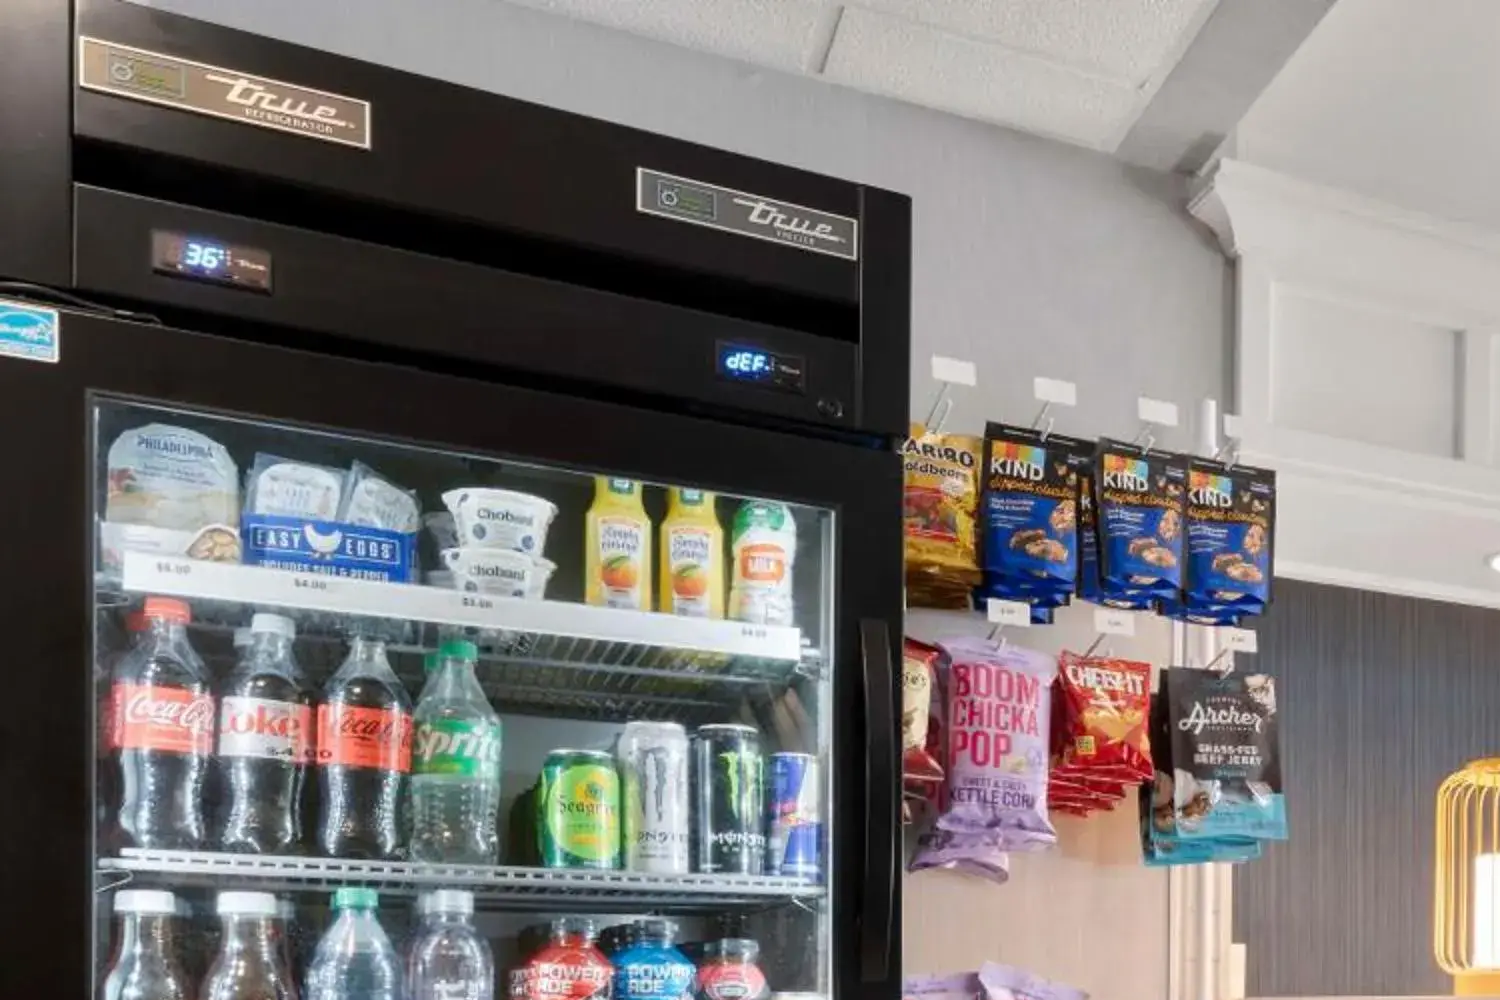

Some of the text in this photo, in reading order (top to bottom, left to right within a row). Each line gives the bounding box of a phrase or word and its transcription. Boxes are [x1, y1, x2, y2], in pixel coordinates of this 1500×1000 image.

[903, 438, 974, 469] ARIBO
[990, 457, 1045, 481] KIND
[1103, 470, 1149, 492] KIND
[1187, 486, 1234, 508] KIND
[256, 529, 302, 549] EASY
[952, 662, 1040, 705] BOOM
[953, 698, 1040, 737] CHICKA
[1178, 700, 1263, 736] Archer
[950, 730, 1012, 768] POP
